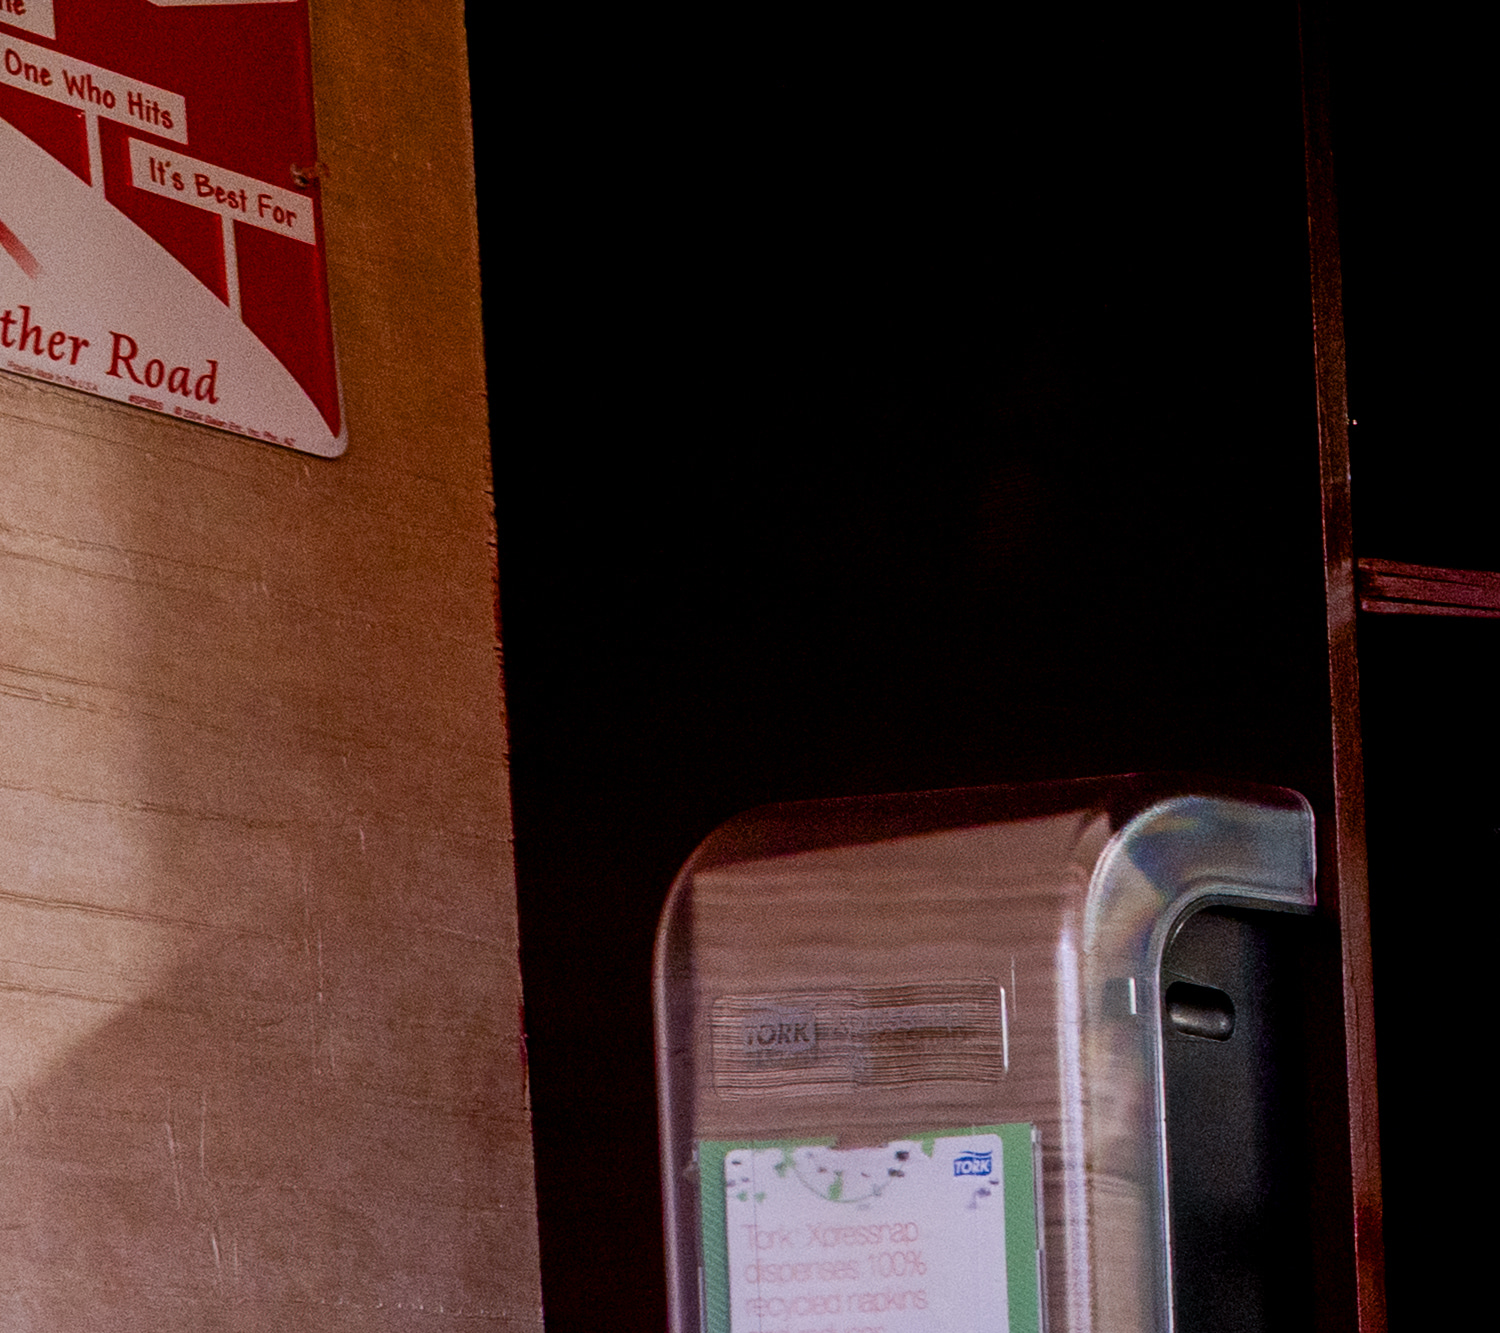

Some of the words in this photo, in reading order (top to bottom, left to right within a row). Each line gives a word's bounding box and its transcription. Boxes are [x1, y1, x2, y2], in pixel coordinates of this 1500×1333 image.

[4, 48, 53, 86] One
[62, 69, 116, 110] Who
[127, 90, 174, 130] Hits
[149, 157, 185, 191] It's
[194, 174, 248, 213] Best
[257, 193, 298, 229] For
[106, 330, 220, 404] Road
[954, 1157, 992, 1175] TORK
[867, 1250, 927, 1278] 100%
